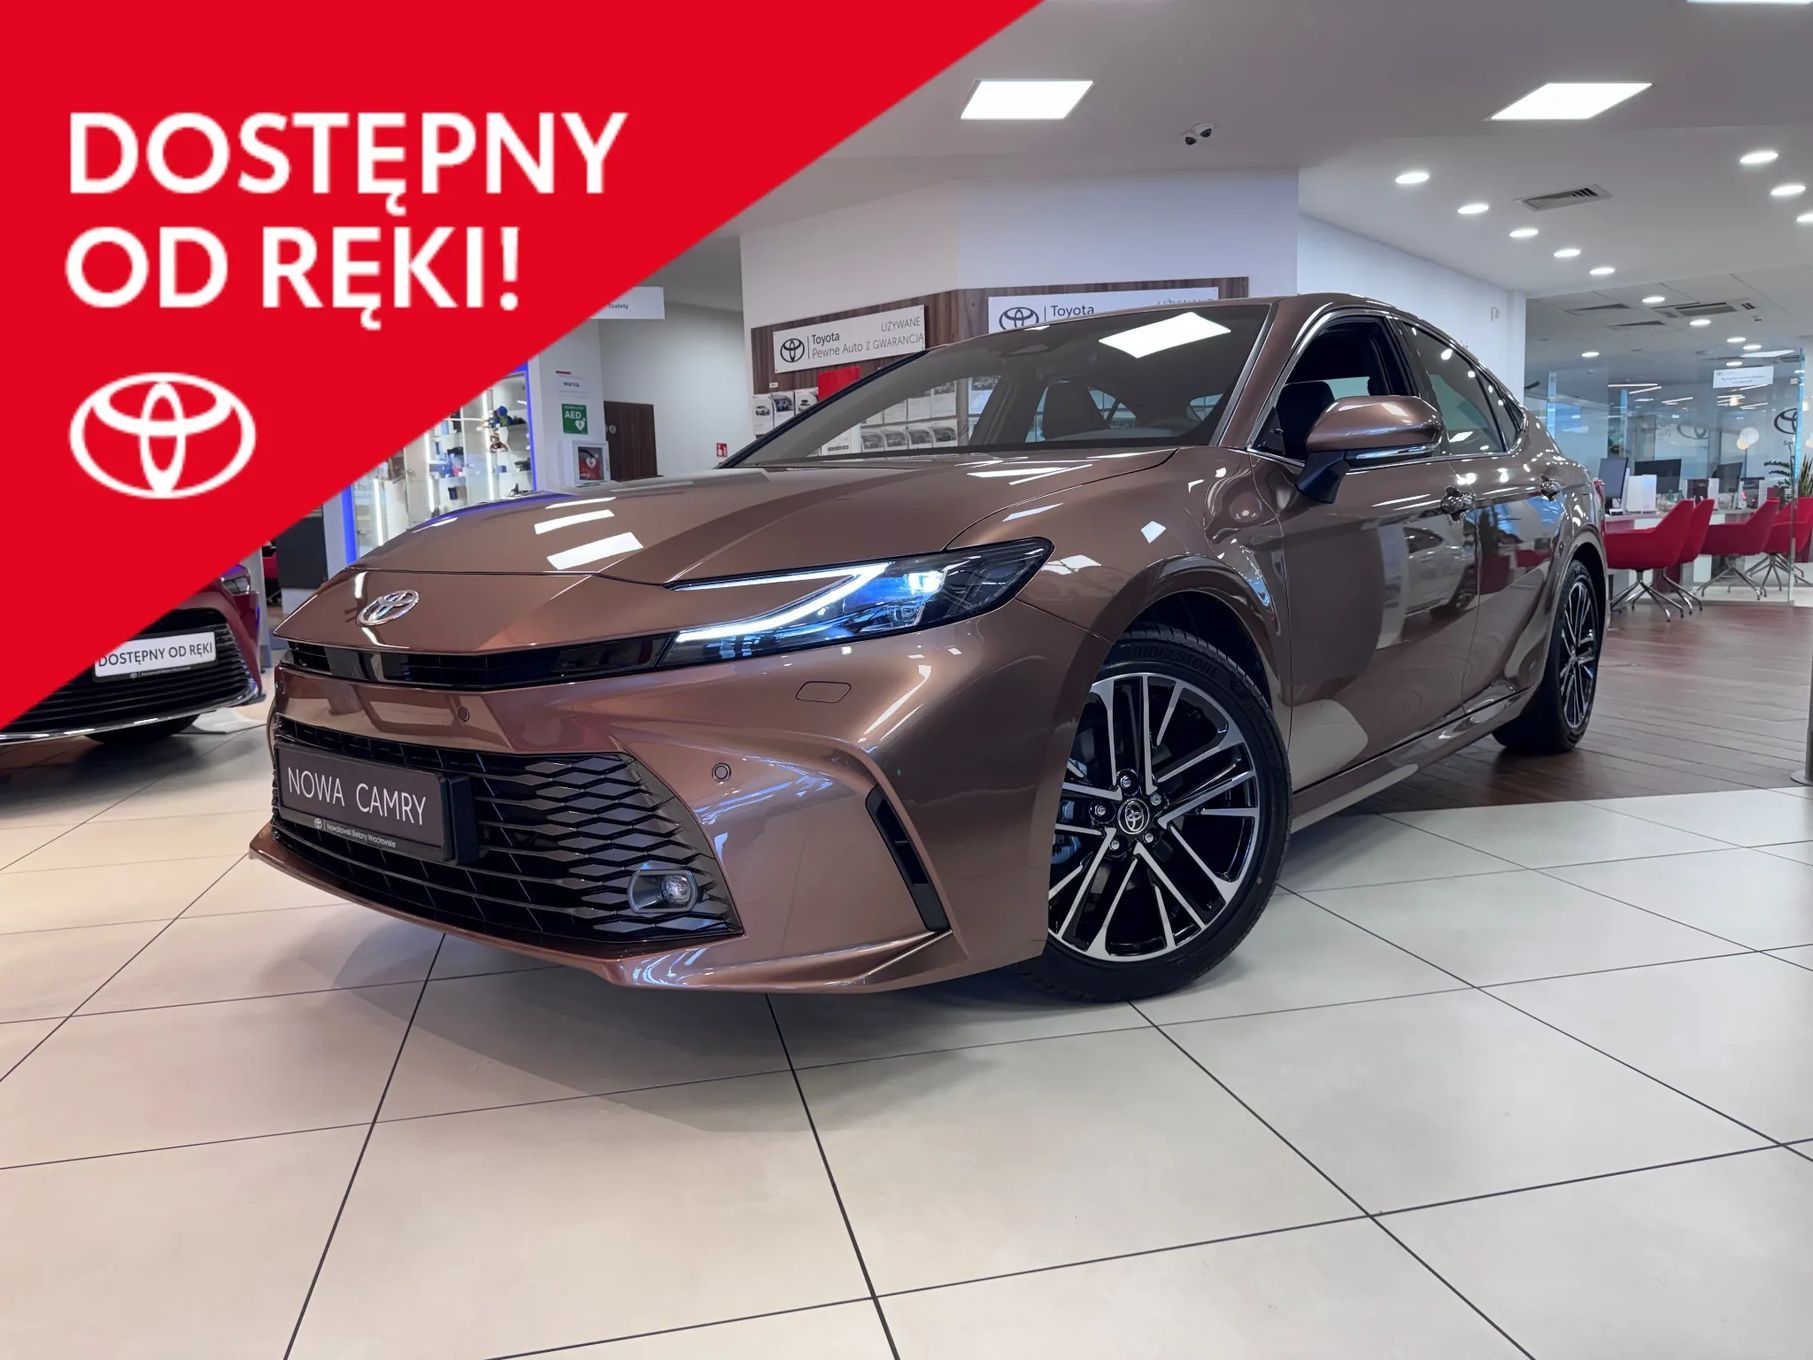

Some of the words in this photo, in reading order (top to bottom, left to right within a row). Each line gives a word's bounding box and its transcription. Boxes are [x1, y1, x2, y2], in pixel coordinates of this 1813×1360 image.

[1050, 304, 1095, 319] Toyota
[811, 332, 840, 346] Toyota
[812, 347, 840, 359] Pewne
[842, 342, 864, 354] Auto
[564, 410, 582, 419] AED
[98, 648, 166, 667] DOSTĘPNY
[168, 645, 187, 658] OD
[189, 642, 213, 657] RĘKI
[1127, 645, 1218, 678] RIDGESTONE
[287, 767, 345, 807] NOWA
[355, 783, 427, 826] CAMRY
